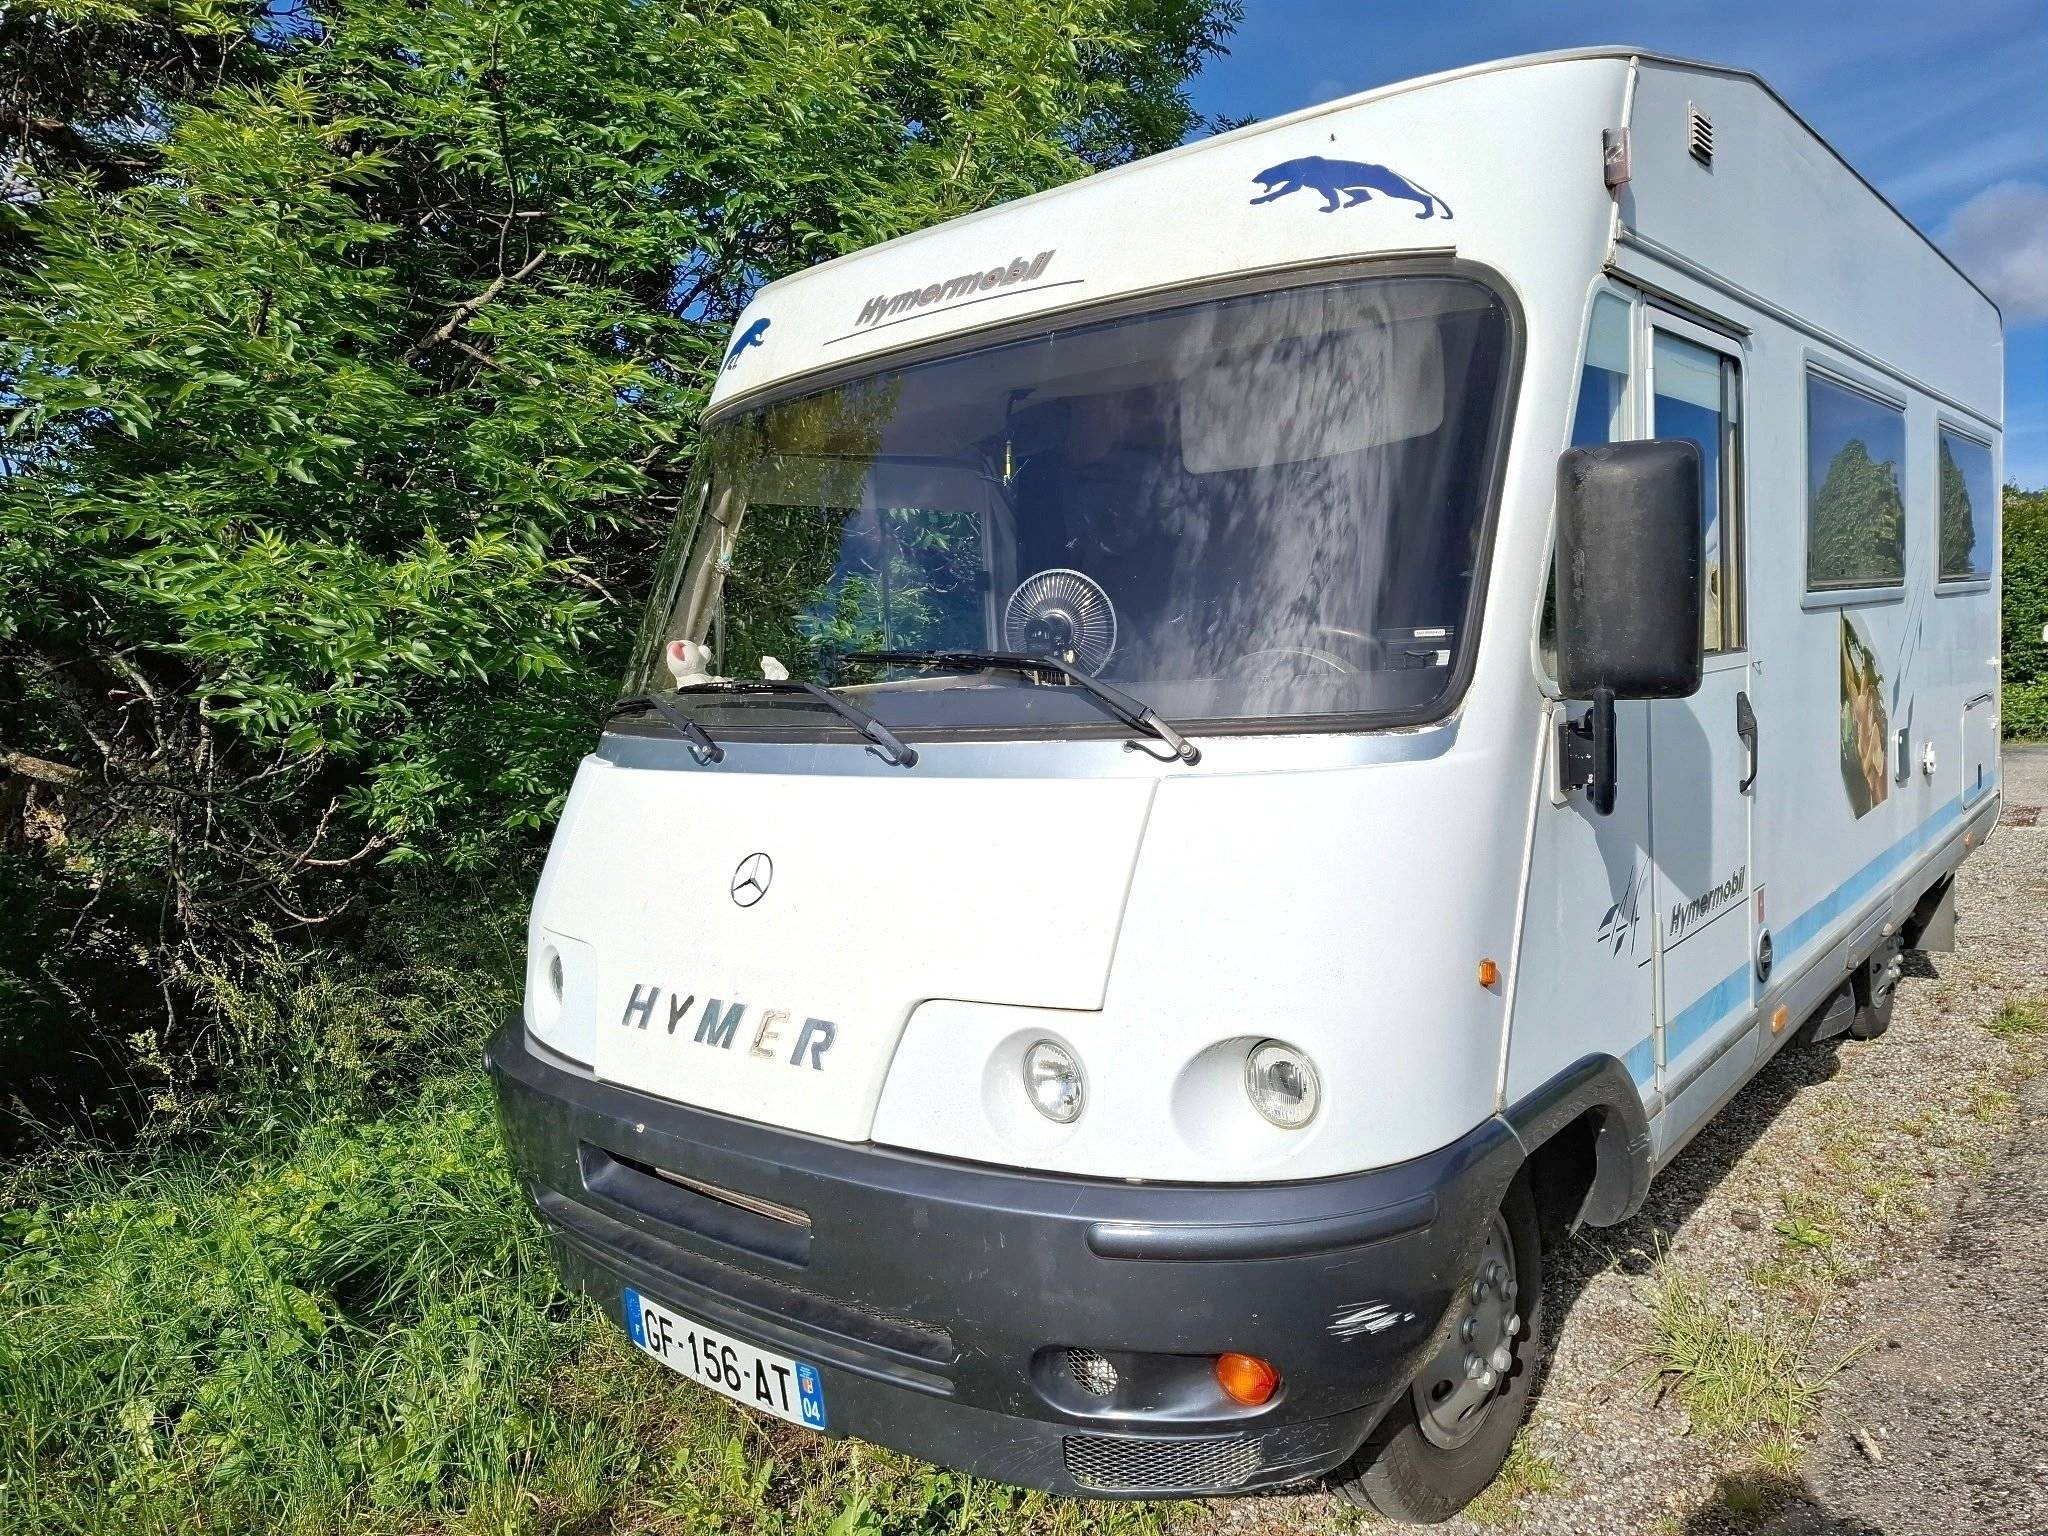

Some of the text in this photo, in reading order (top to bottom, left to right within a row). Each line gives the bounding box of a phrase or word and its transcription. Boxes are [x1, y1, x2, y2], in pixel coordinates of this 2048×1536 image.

[855, 249, 1056, 326] Hymermobil
[1669, 864, 1746, 937] Hymermobil
[621, 983, 838, 1071] HYMER
[644, 1308, 791, 1411] GF-156-AT
[802, 1397, 821, 1421] 04
